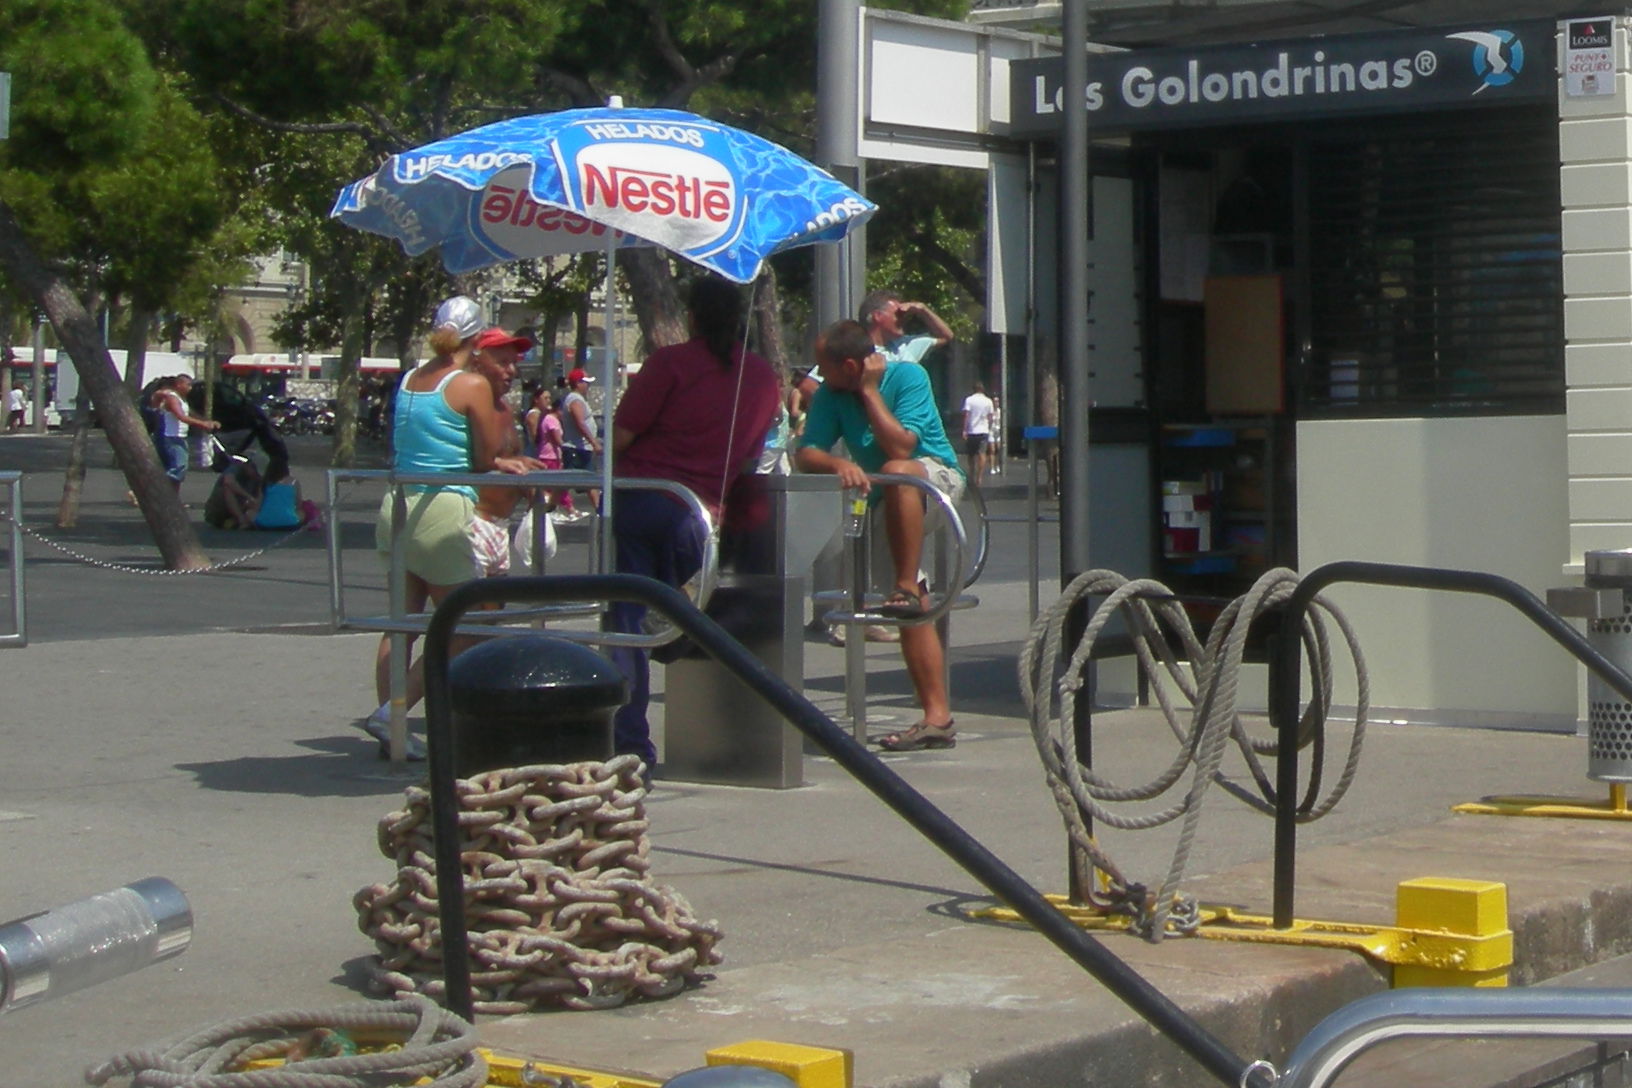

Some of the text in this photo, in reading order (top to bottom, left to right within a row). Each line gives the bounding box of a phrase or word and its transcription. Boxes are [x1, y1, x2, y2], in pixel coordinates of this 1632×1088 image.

[1572, 35, 1608, 46] LOOMIS
[1569, 62, 1612, 73] SEGURO
[1035, 75, 1104, 114] Ls
[584, 124, 705, 148] HELADOS
